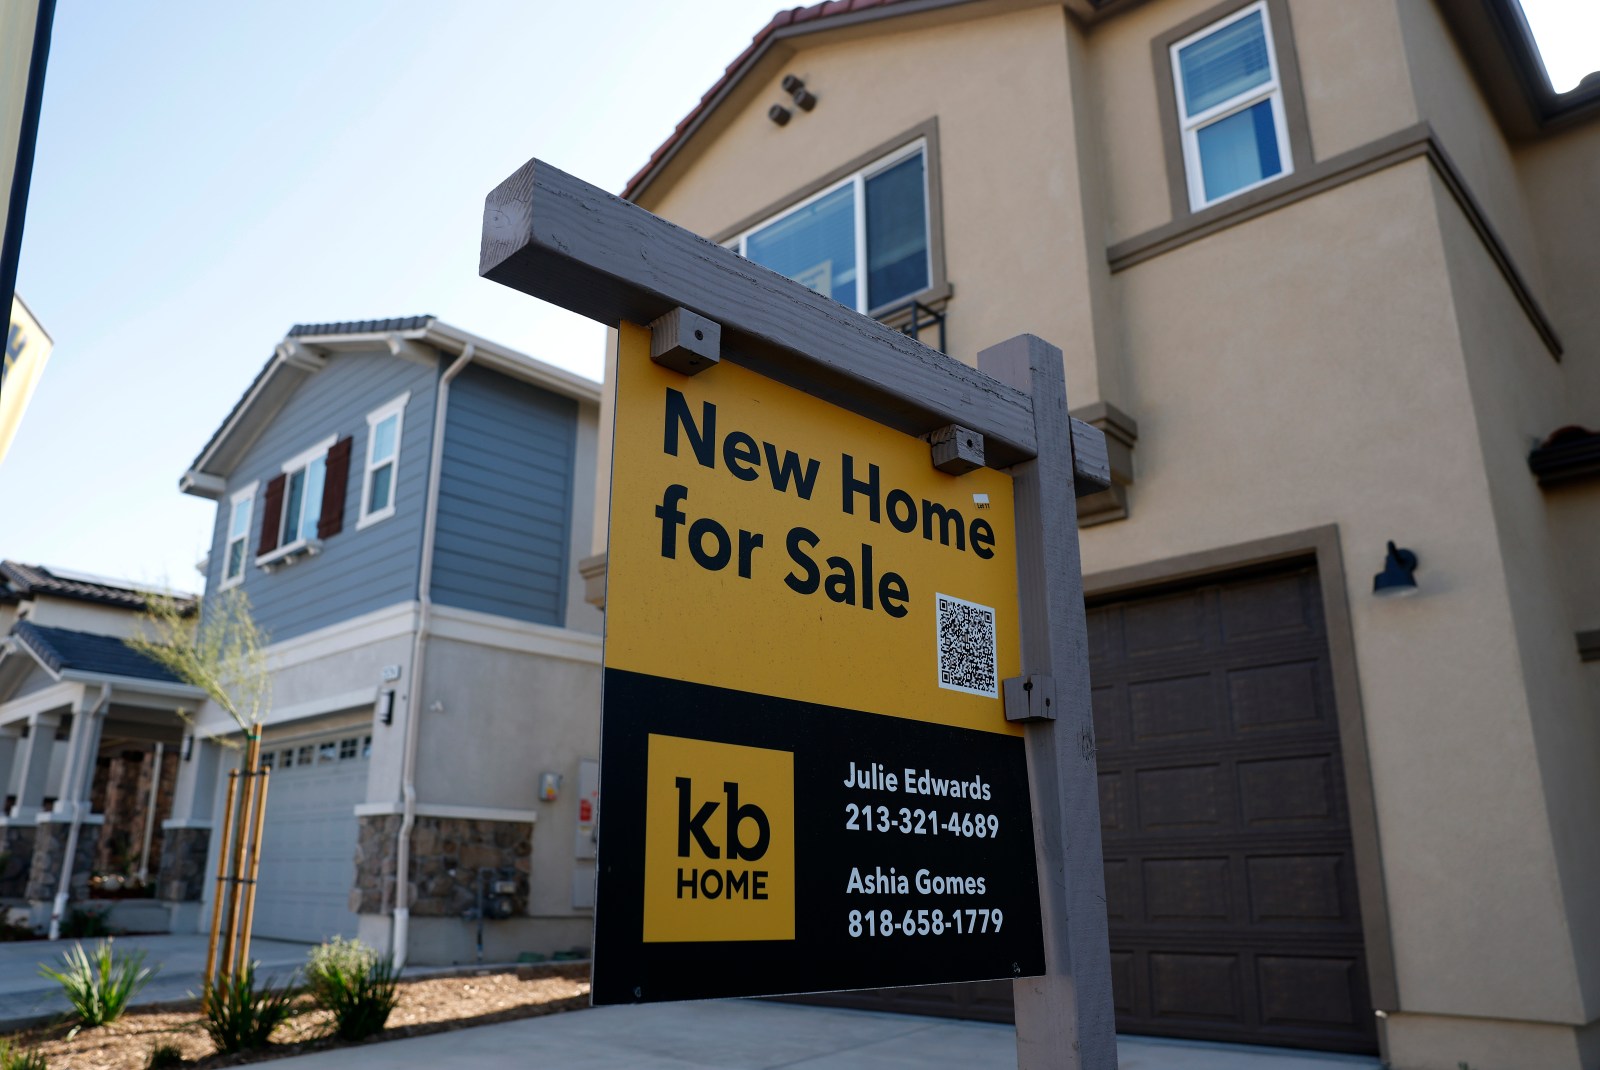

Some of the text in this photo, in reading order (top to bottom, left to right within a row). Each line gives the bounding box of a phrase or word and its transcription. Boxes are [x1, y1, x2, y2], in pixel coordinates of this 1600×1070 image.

[664, 386, 996, 560] New Home
[655, 484, 910, 619] for Sale
[844, 762, 992, 801] Julie Edwards
[675, 776, 771, 862] kb
[845, 803, 999, 839] 213-321-4689
[676, 867, 769, 900] HOME
[846, 866, 987, 895] Ashia Gomes
[848, 908, 1004, 938] 818-658-1779
